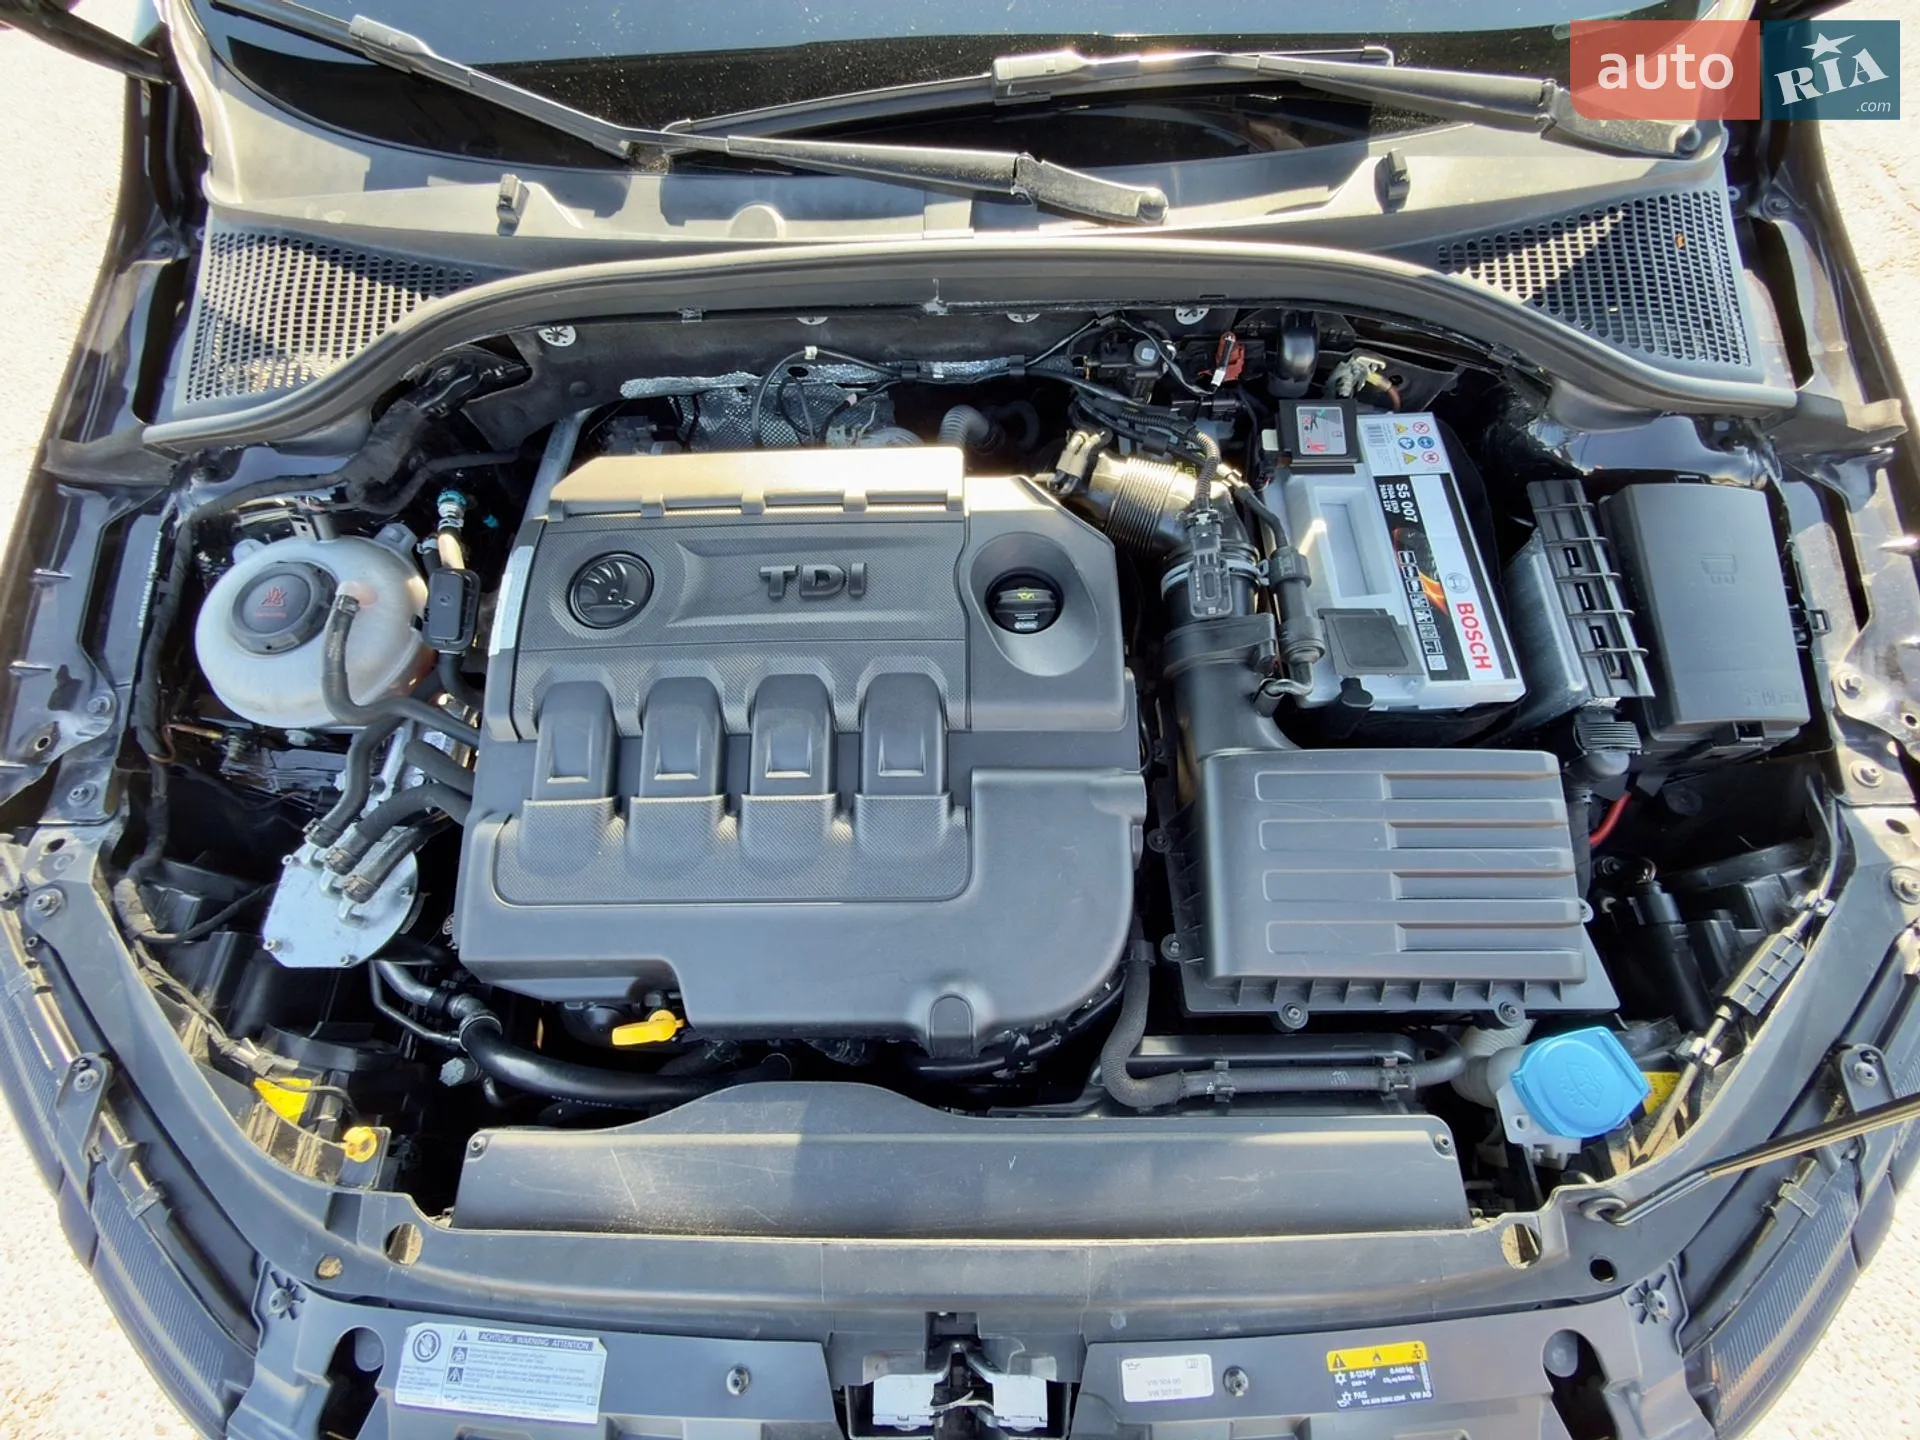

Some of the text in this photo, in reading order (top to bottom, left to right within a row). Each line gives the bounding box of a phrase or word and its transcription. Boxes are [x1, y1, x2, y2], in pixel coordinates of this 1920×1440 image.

[1396, 483, 1419, 523] S5 007
[758, 561, 868, 602] TDI
[1456, 602, 1492, 669] BOSCH
[480, 1334, 590, 1350] ACHTUNG WARNING ATTENTION
